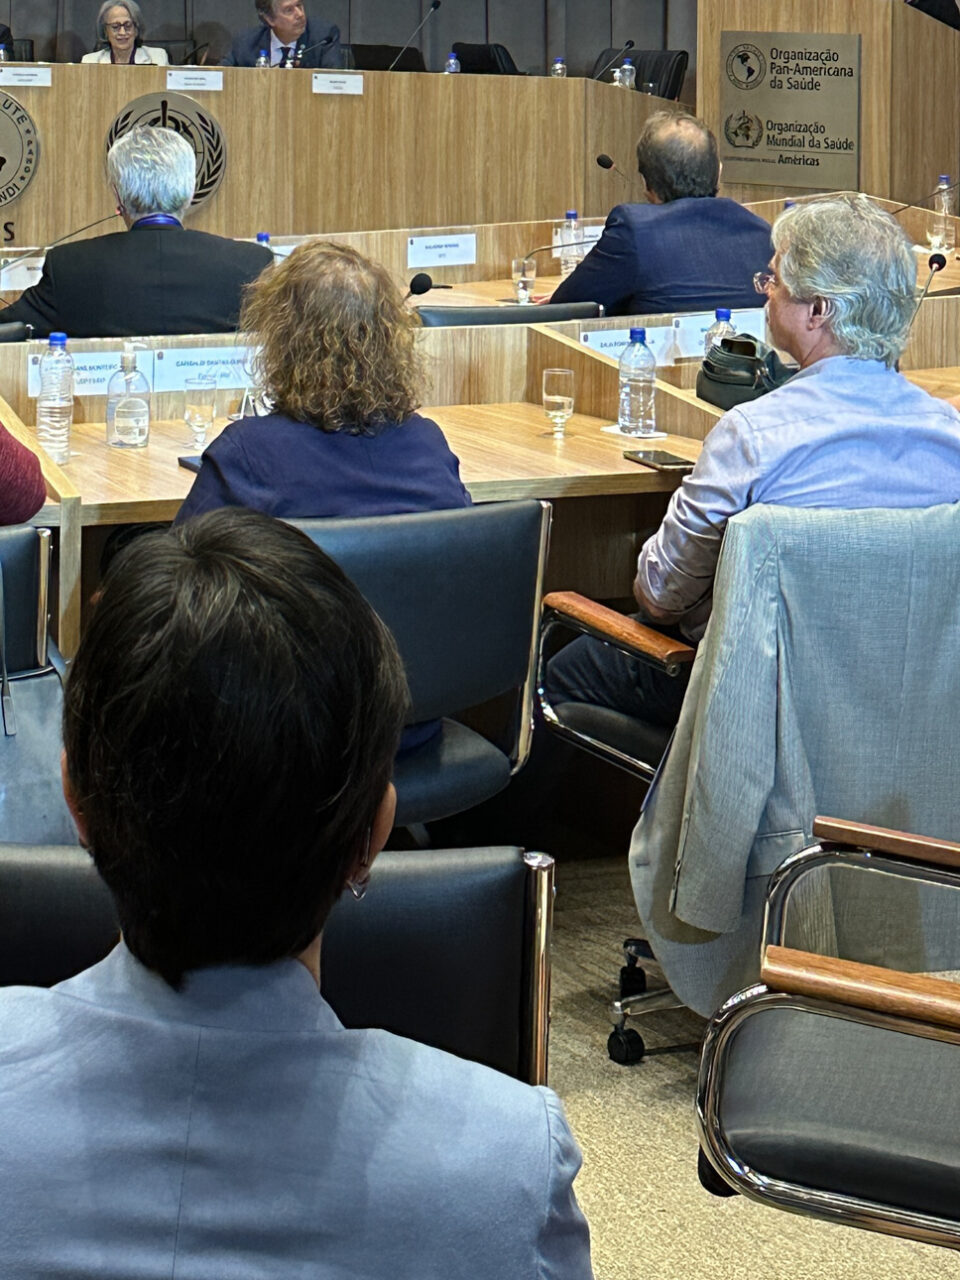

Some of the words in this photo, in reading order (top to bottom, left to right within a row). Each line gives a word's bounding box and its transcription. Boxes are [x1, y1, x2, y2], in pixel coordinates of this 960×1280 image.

[770, 48, 839, 65] Organização
[770, 63, 854, 77] Pan-Americana
[770, 76, 783, 89] da
[787, 77, 821, 91] Saúde
[766, 120, 826, 137] Organização
[766, 135, 805, 148] Mundial
[809, 136, 821, 149] da
[824, 137, 854, 151] Saúde
[778, 154, 820, 166] Américas
